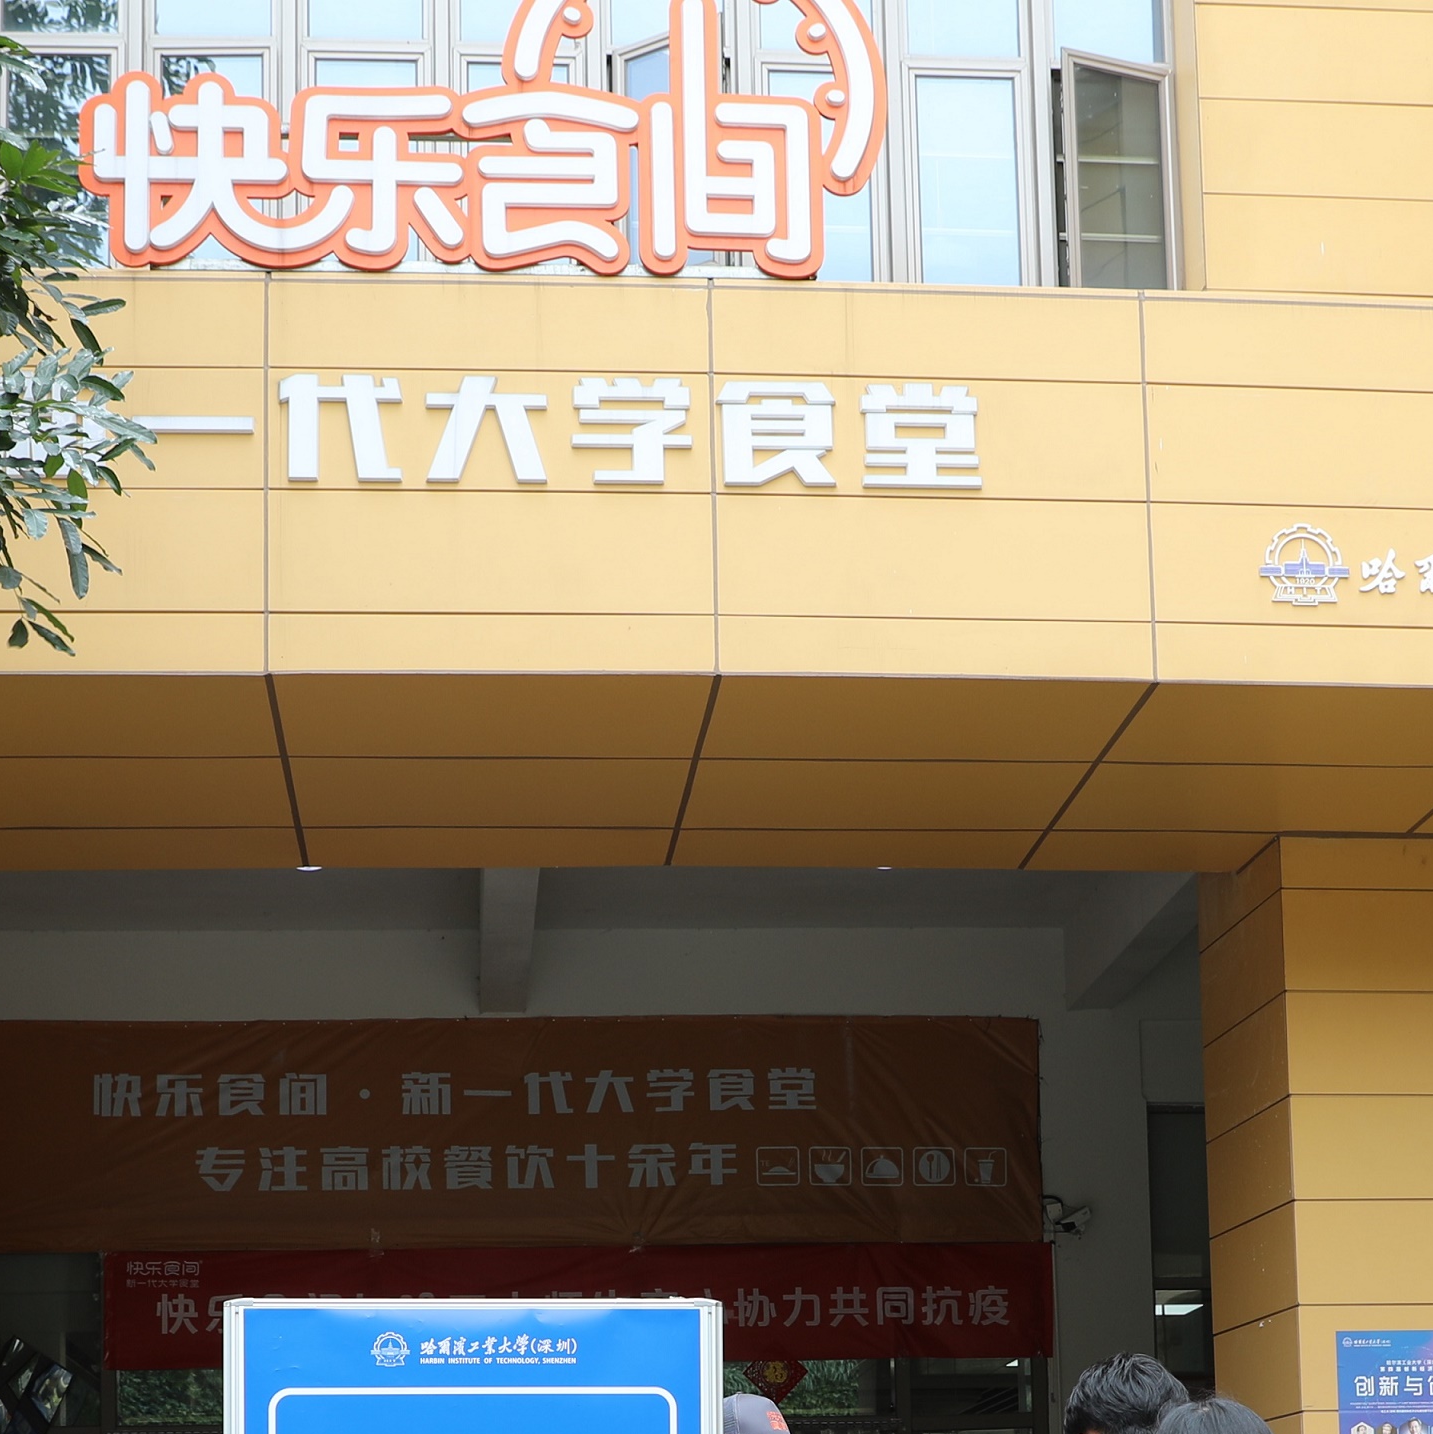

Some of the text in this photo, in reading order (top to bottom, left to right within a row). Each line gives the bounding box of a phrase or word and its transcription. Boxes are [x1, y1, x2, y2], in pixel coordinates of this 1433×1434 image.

[80, 0, 828, 278] 快乐食间
[195, 1141, 738, 1192] 专注高校餐饮十余年
[126, 1260, 203, 1277] 快乐食间
[420, 1357, 577, 1366] HARBIN INSTITUTE OF TECHNOLOGY, SHENZHEN
